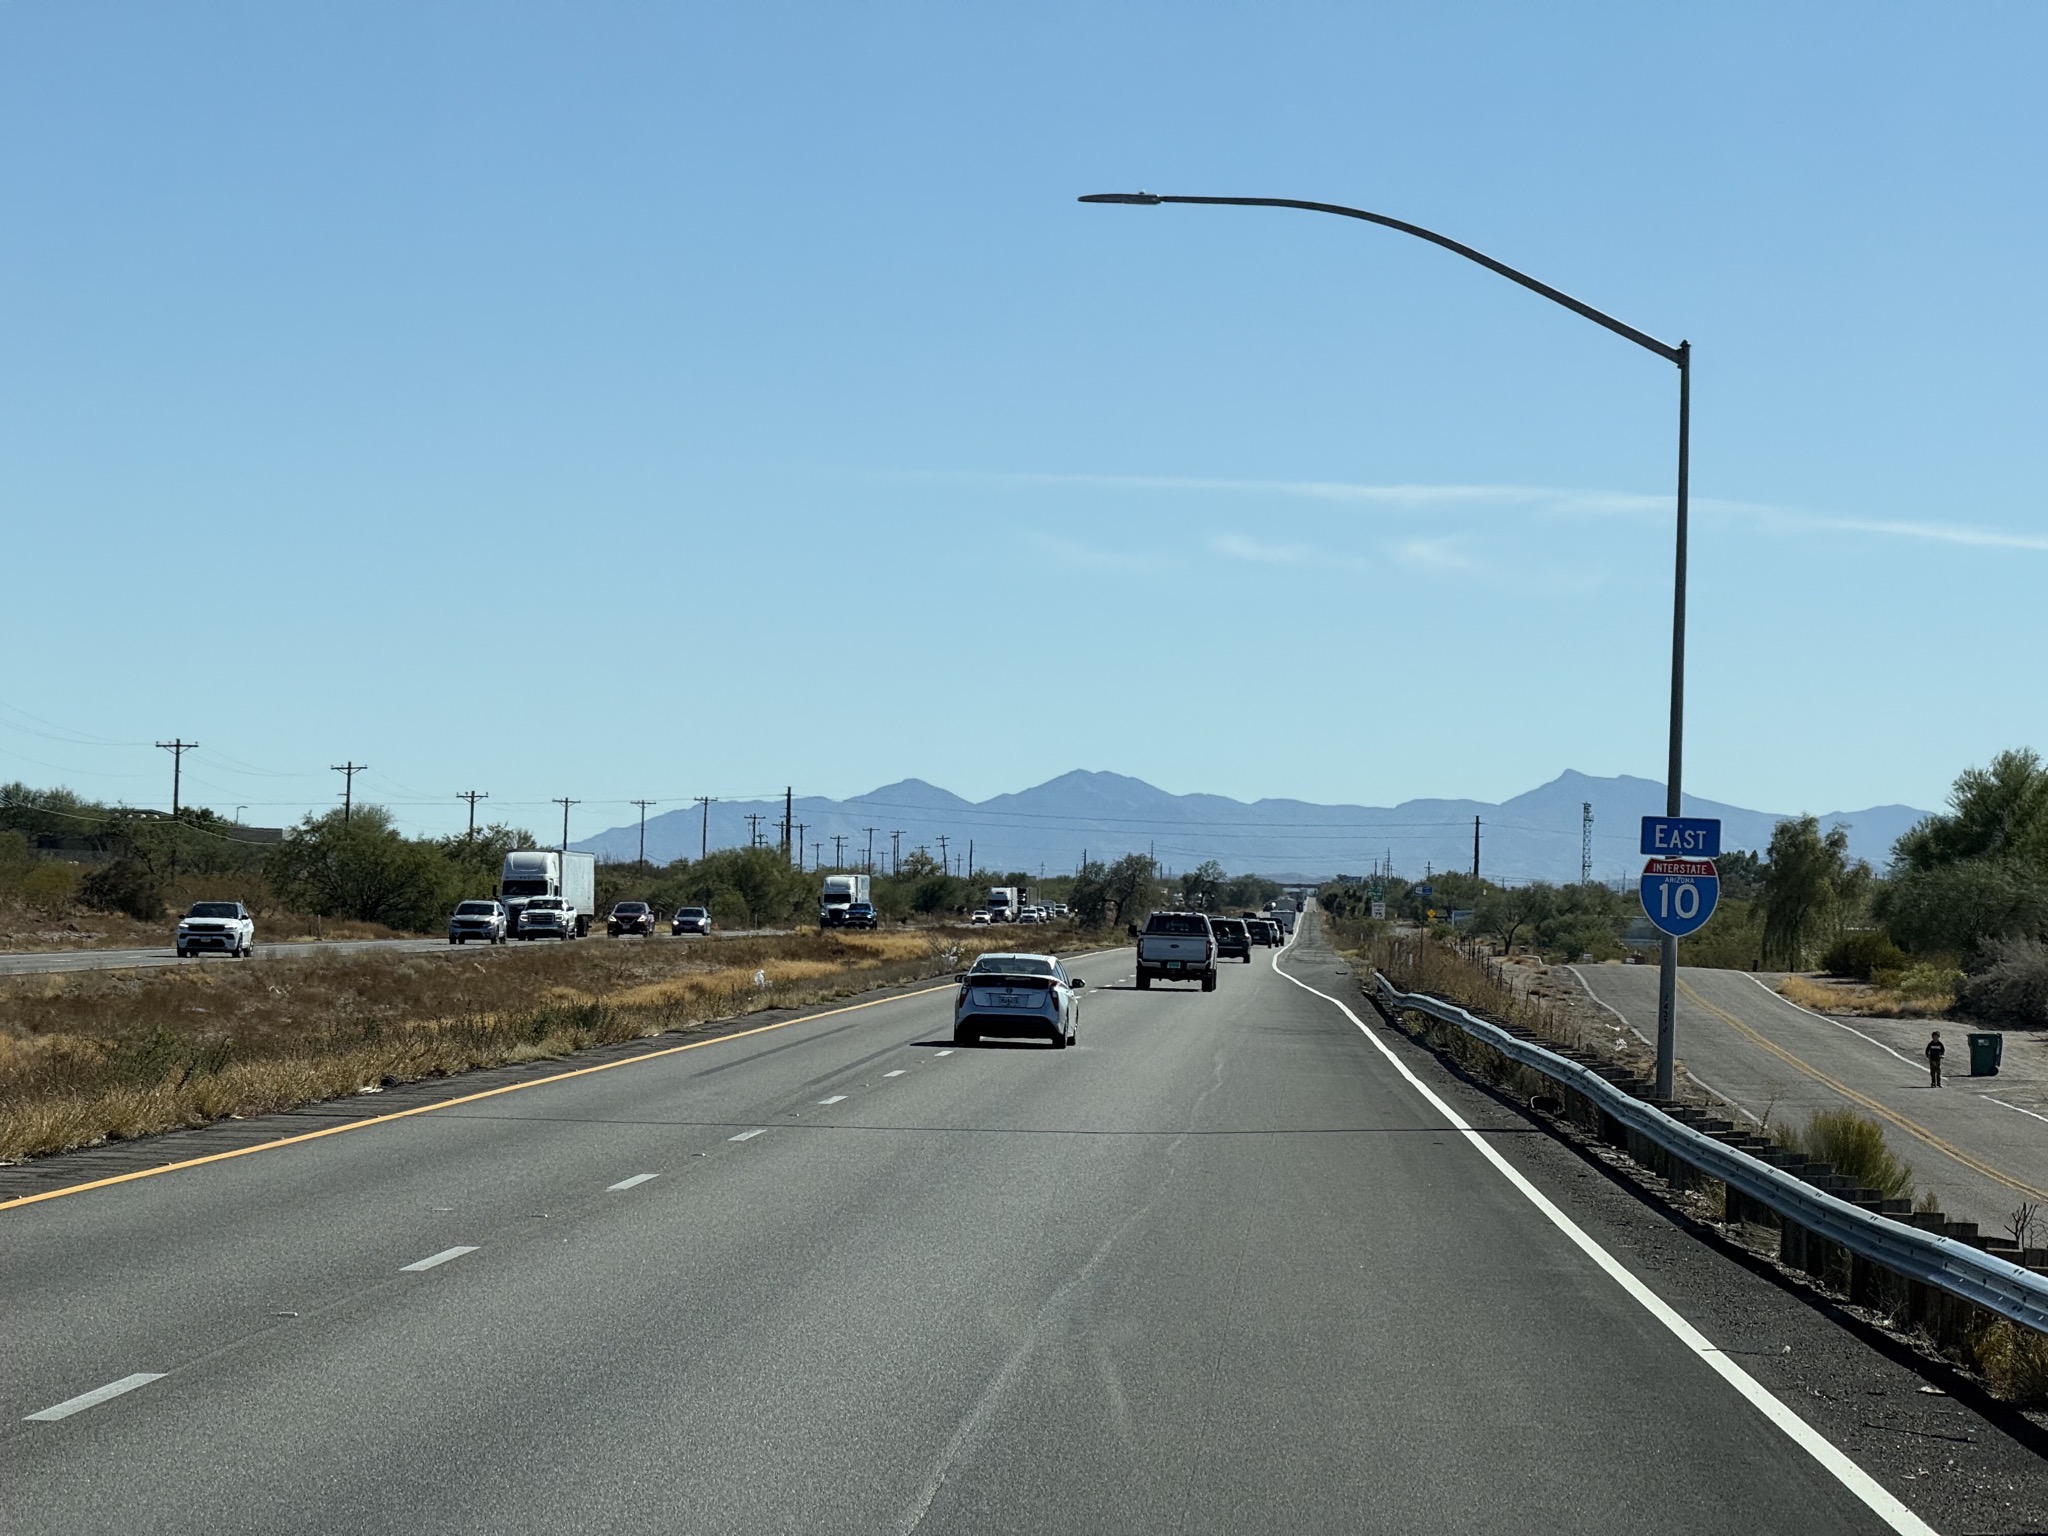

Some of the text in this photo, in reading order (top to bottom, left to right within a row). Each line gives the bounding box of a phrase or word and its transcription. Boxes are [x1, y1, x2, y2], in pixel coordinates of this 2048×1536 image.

[1655, 825, 1706, 849] EAST
[1653, 863, 1707, 874] INTERSTATE
[1659, 884, 1699, 919] 10
